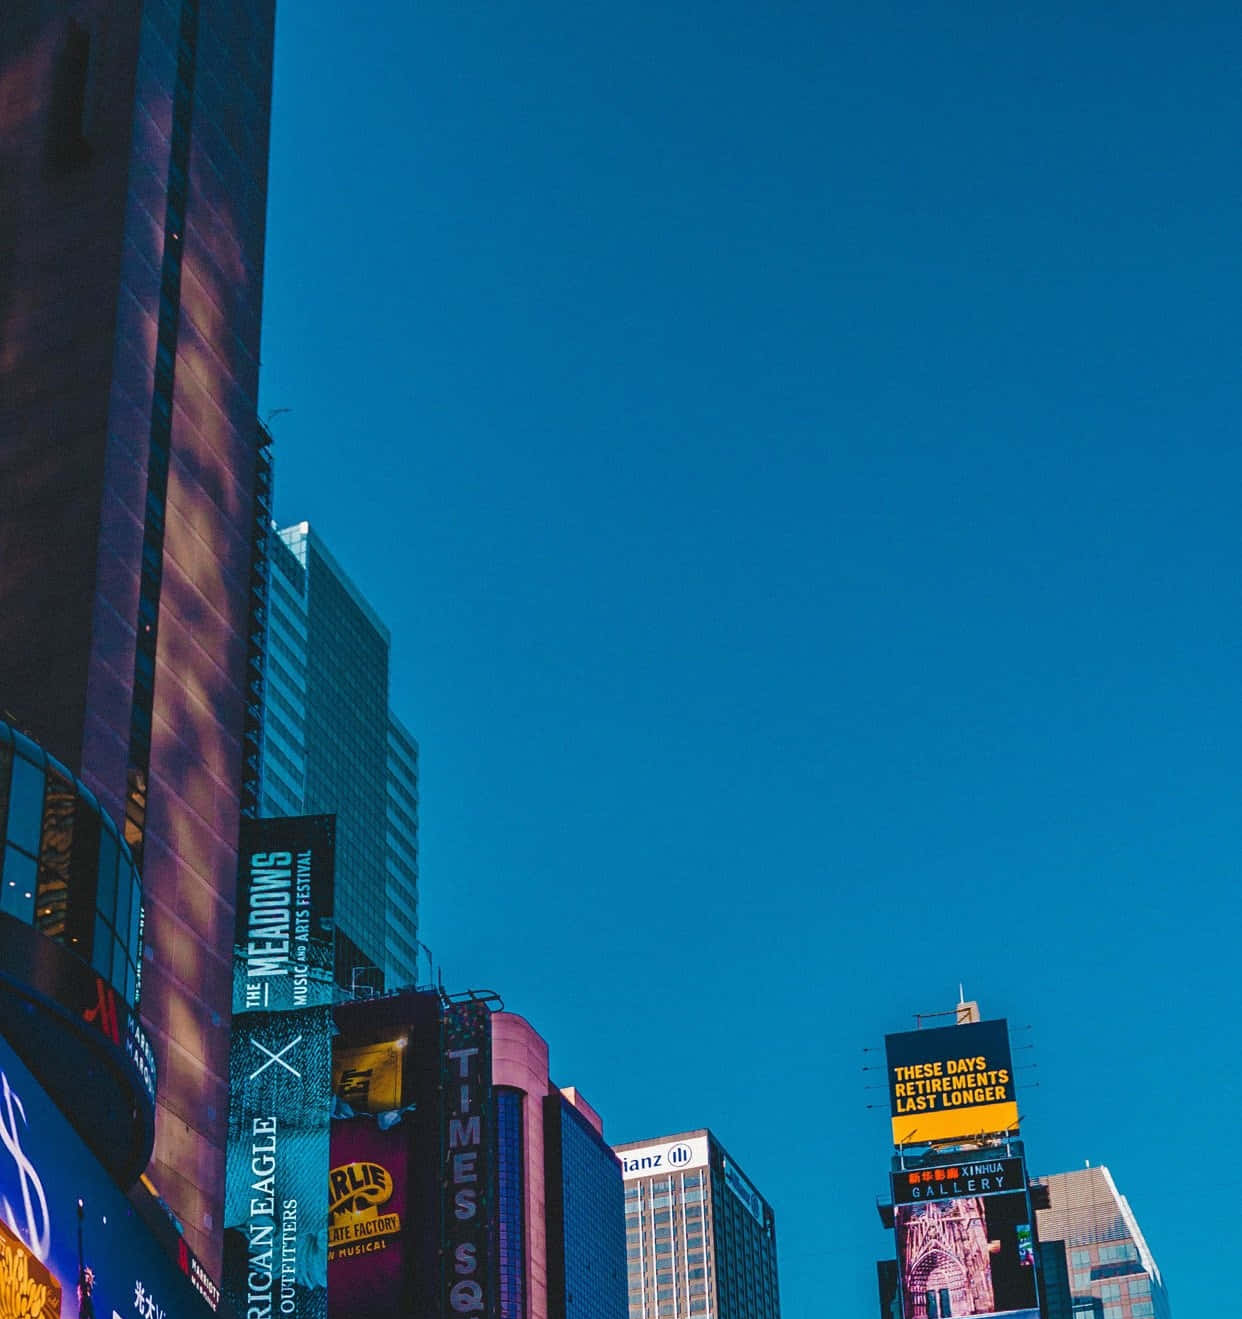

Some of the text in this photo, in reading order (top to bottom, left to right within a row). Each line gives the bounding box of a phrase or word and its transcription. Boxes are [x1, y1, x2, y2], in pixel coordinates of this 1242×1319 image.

[248, 851, 292, 977] MEADOWS
[294, 849, 312, 1006] MUSIC AND ARTS FESTIVAL
[246, 983, 261, 1009] THE
[895, 1056, 987, 1081] THESE DAYS
[895, 1069, 1009, 1097] RETIREMENTS
[896, 1086, 1007, 1113] LAST LONGER
[448, 1047, 480, 1220] TIMES
[251, 1116, 277, 1218] EAGLE
[961, 1162, 1005, 1177] XINHUA
[912, 1176, 1004, 1198] GALLERY
[354, 1216, 397, 1236] FACTORY
[280, 1199, 298, 1314] OUTFITTERS
[339, 1240, 387, 1258] MUSICAL
